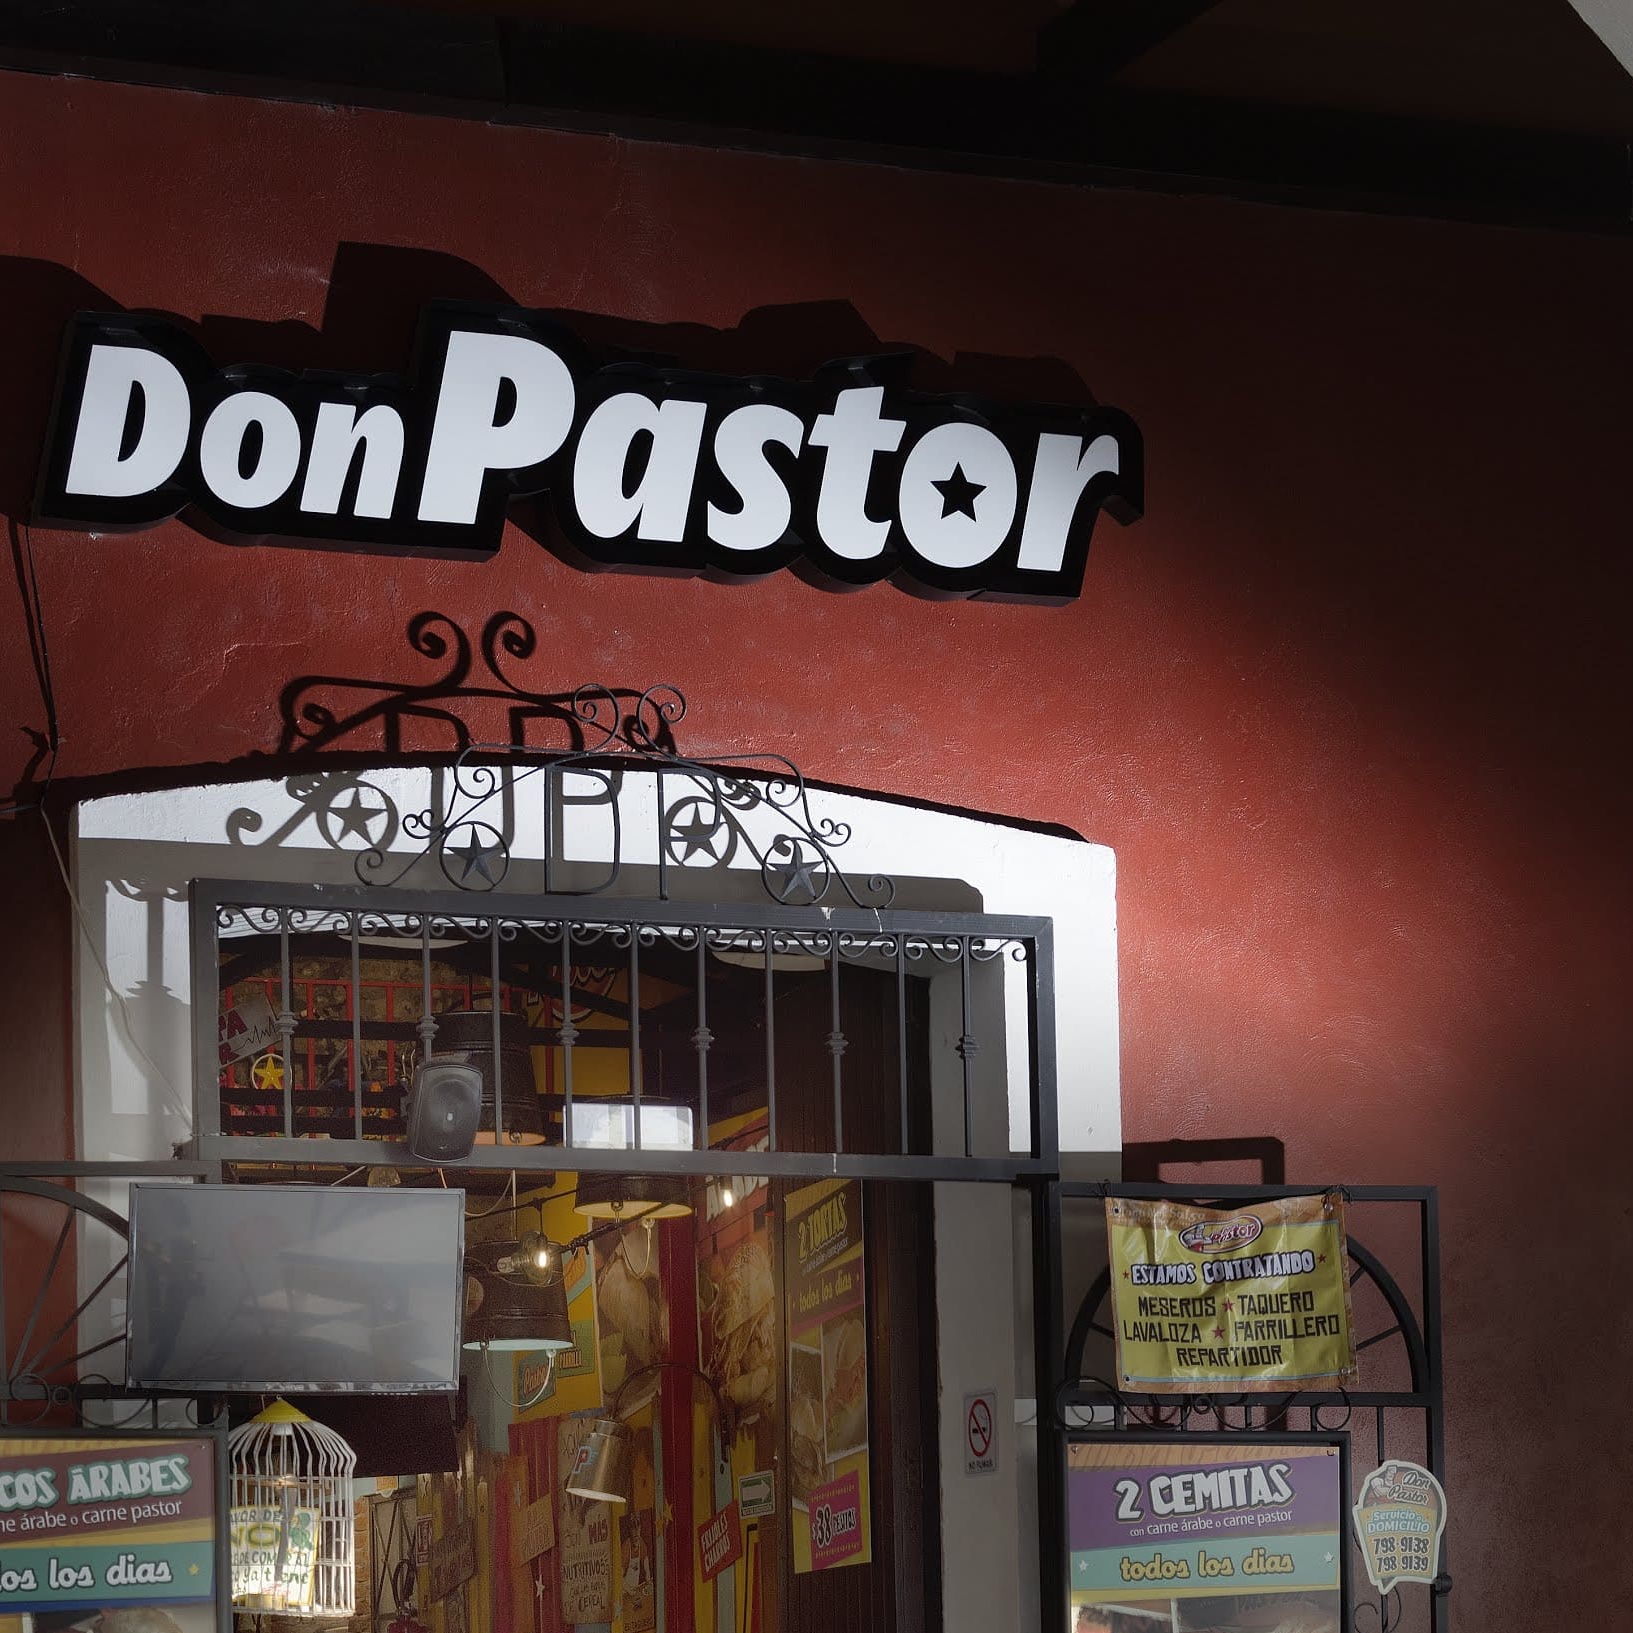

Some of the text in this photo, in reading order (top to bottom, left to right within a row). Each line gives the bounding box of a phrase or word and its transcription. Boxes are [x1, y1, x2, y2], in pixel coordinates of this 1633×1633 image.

[798, 1221, 807, 1261] 2
[808, 1191, 847, 1254] TORTAS
[1131, 1250, 1314, 1286] ESTAMOS CONTRATANDO
[821, 1277, 833, 1302] los
[1138, 1291, 1314, 1317] MESEROS TAQUERO
[1124, 1314, 1340, 1344] LAVALOZA PARRILLERO
[1176, 1345, 1283, 1367] REPARTIDOR
[1116, 1463, 1293, 1520] 2 CEMITAS
[1388, 1485, 1429, 1505] Pastor
[1403, 1471, 1430, 1489] Don
[20, 1510, 67, 1531] árabe
[70, 1516, 78, 1525] o
[82, 1507, 127, 1526] carne
[131, 1500, 182, 1523] pastor
[816, 1504, 832, 1549] 38
[831, 1507, 857, 1537] PESITOS
[1130, 1528, 1144, 1537] con
[1147, 1521, 1178, 1535] carne
[1182, 1517, 1213, 1532] árabe
[1224, 1513, 1255, 1527] carne
[1257, 1510, 1293, 1526] pastor
[1368, 1521, 1431, 1533] DOMICILIO
[1374, 1511, 1415, 1521] Servicio
[701, 1511, 728, 1553] FRIJOLES
[49, 1557, 95, 1590] los
[106, 1553, 173, 1587] dias
[1120, 1547, 1295, 1582] todos los dias
